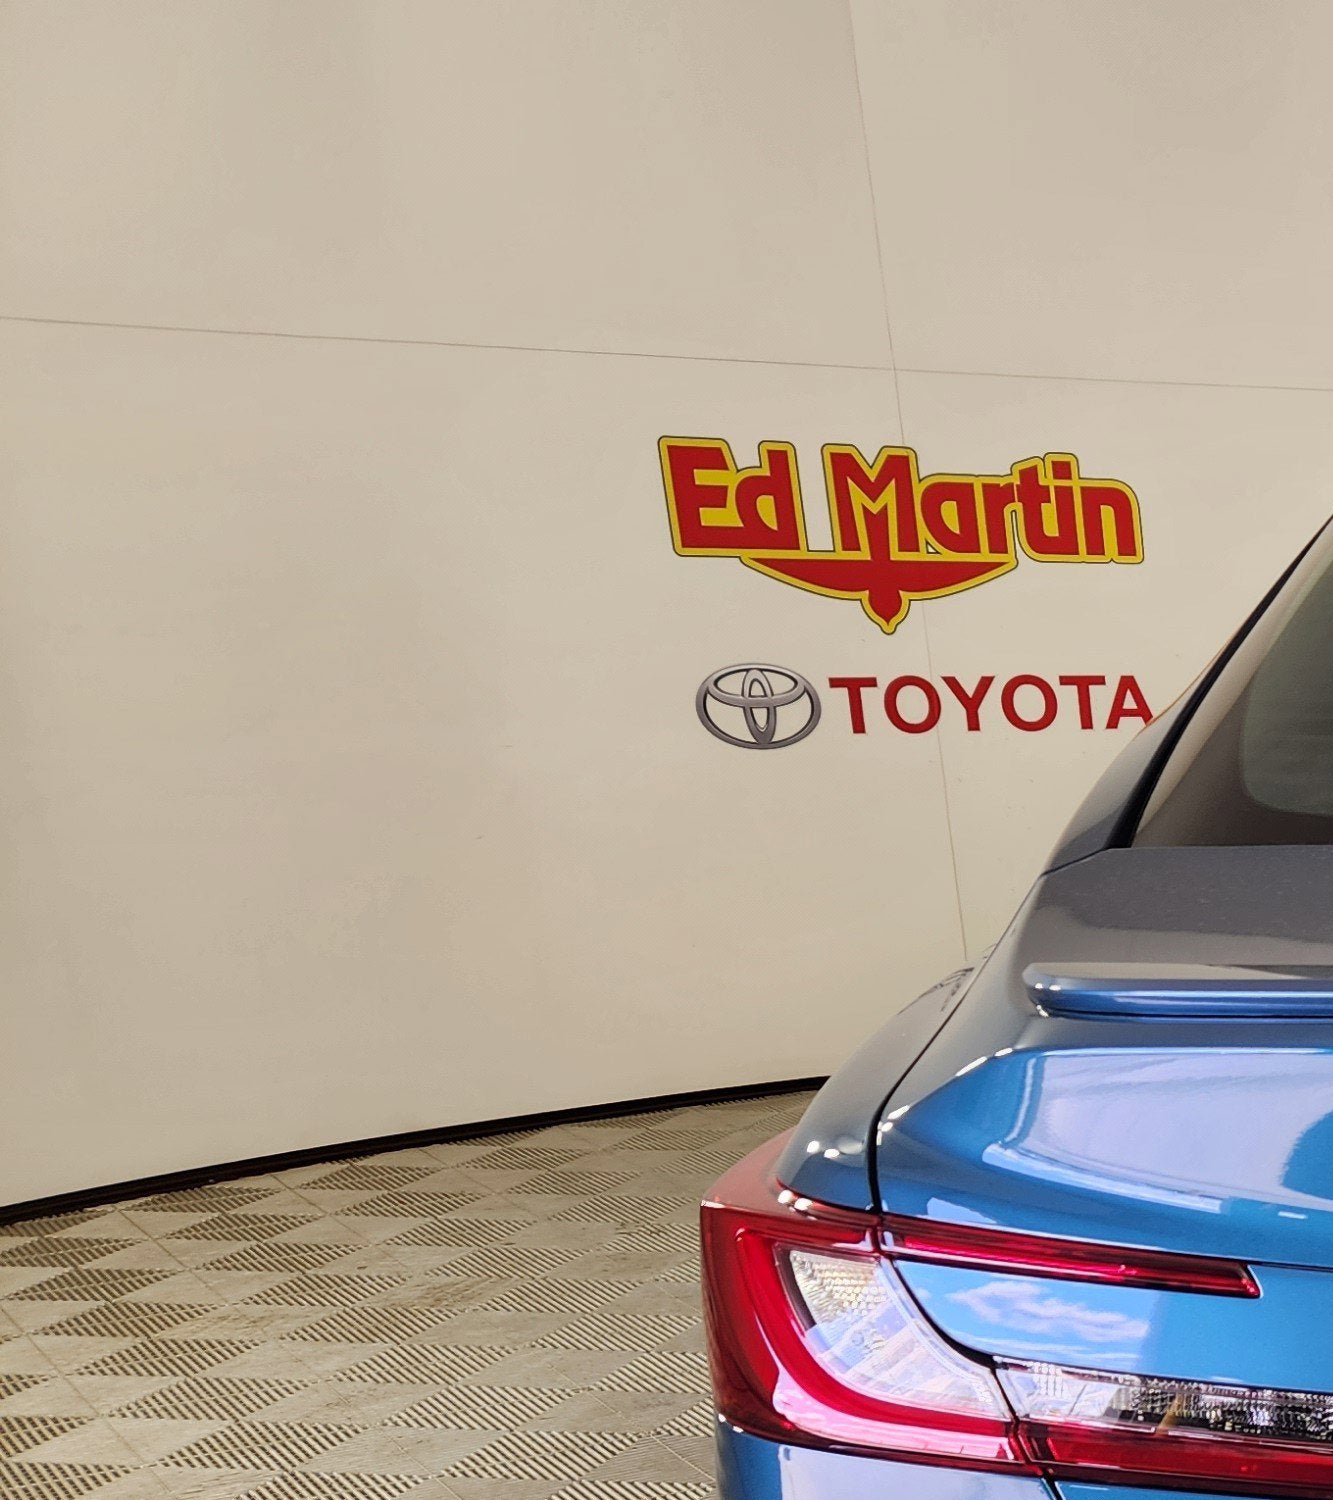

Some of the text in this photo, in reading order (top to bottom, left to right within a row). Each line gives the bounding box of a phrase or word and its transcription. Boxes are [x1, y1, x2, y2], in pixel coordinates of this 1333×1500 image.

[658, 436, 1144, 564] Ed Martin
[828, 674, 1154, 734] TOYOTA
